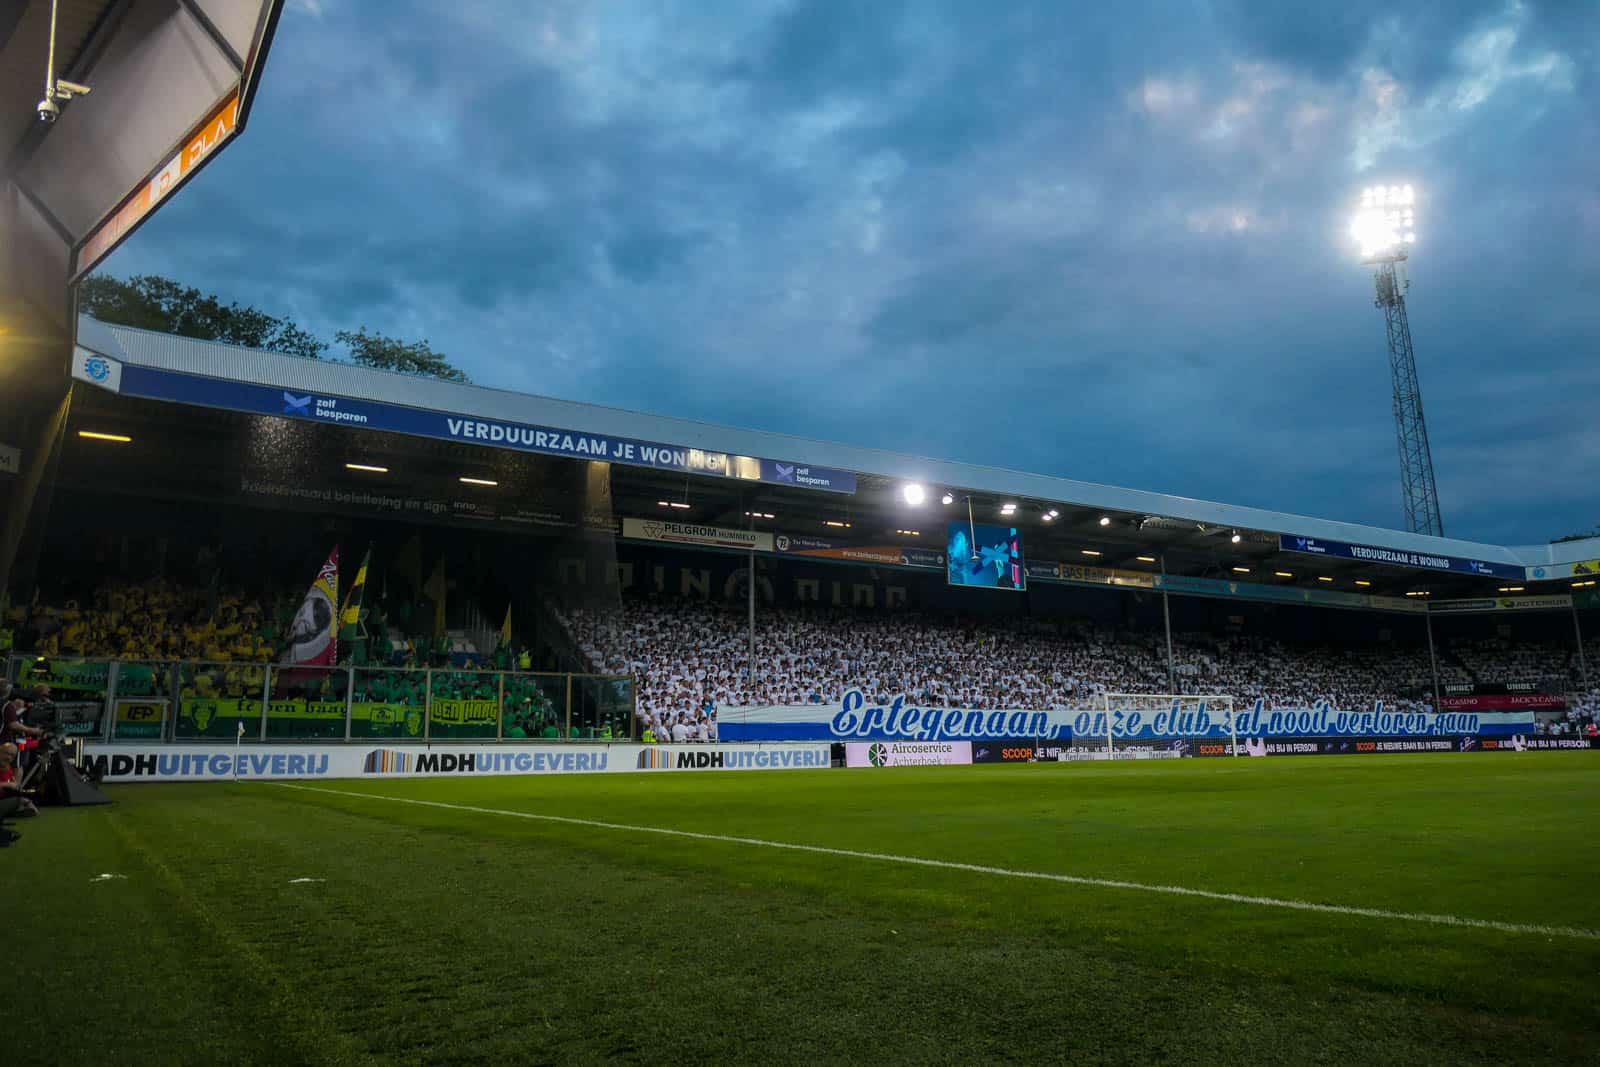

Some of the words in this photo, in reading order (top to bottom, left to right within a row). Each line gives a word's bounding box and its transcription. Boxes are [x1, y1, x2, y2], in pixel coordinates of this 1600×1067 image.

[316, 399, 337, 409] zelf
[315, 407, 368, 424] besparen
[447, 418, 608, 456] VERDUURZAAM
[612, 443, 635, 460] JE
[664, 523, 717, 538] PELGROM
[1350, 546, 1409, 566] VERDUURZAAM
[1408, 555, 1419, 566] JE
[1418, 556, 1450, 570] WONING
[1072, 708, 1143, 737] onze
[1150, 698, 1211, 737] club
[1219, 697, 1265, 737] zal
[1267, 696, 1331, 736] nooit
[1335, 699, 1434, 737] verloren
[1433, 711, 1481, 738] gaan
[892, 742, 953, 754] Aircoservice
[1001, 747, 1033, 759] SCOOR
[415, 751, 608, 774] MDHUITGEVERIJ
[676, 750, 830, 770] MDHUITGEVERIJ
